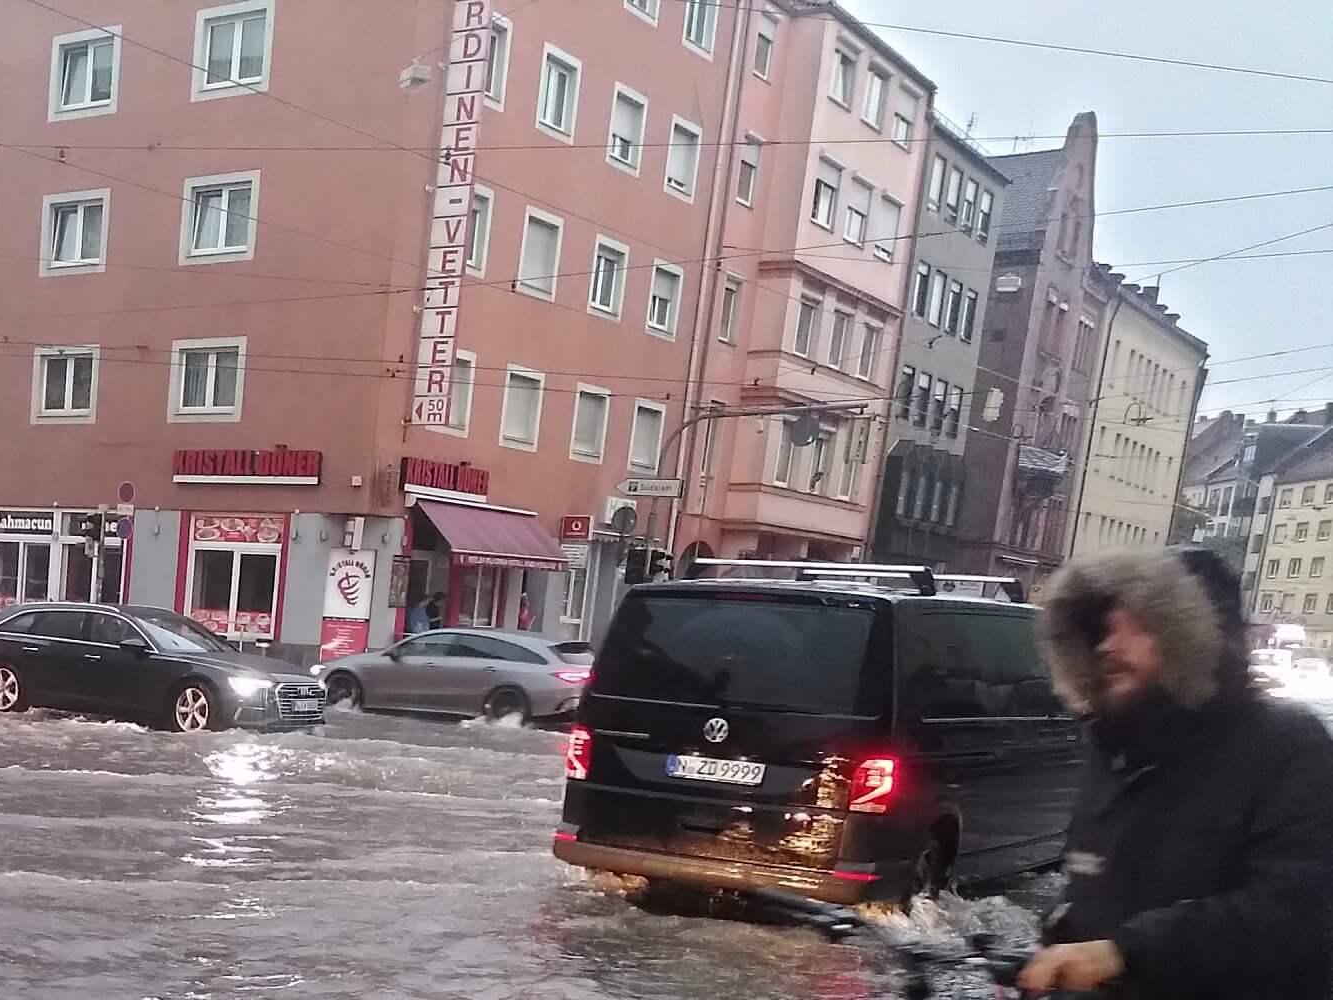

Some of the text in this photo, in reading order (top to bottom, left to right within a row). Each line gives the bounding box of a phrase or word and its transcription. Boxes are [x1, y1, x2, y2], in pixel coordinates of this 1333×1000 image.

[427, 400, 444, 422] 50 m
[173, 444, 319, 476] KRISTALL DÖNER
[407, 457, 455, 491] KRISTALL
[456, 461, 490, 495] DÖNER
[720, 762, 762, 780] 9999
